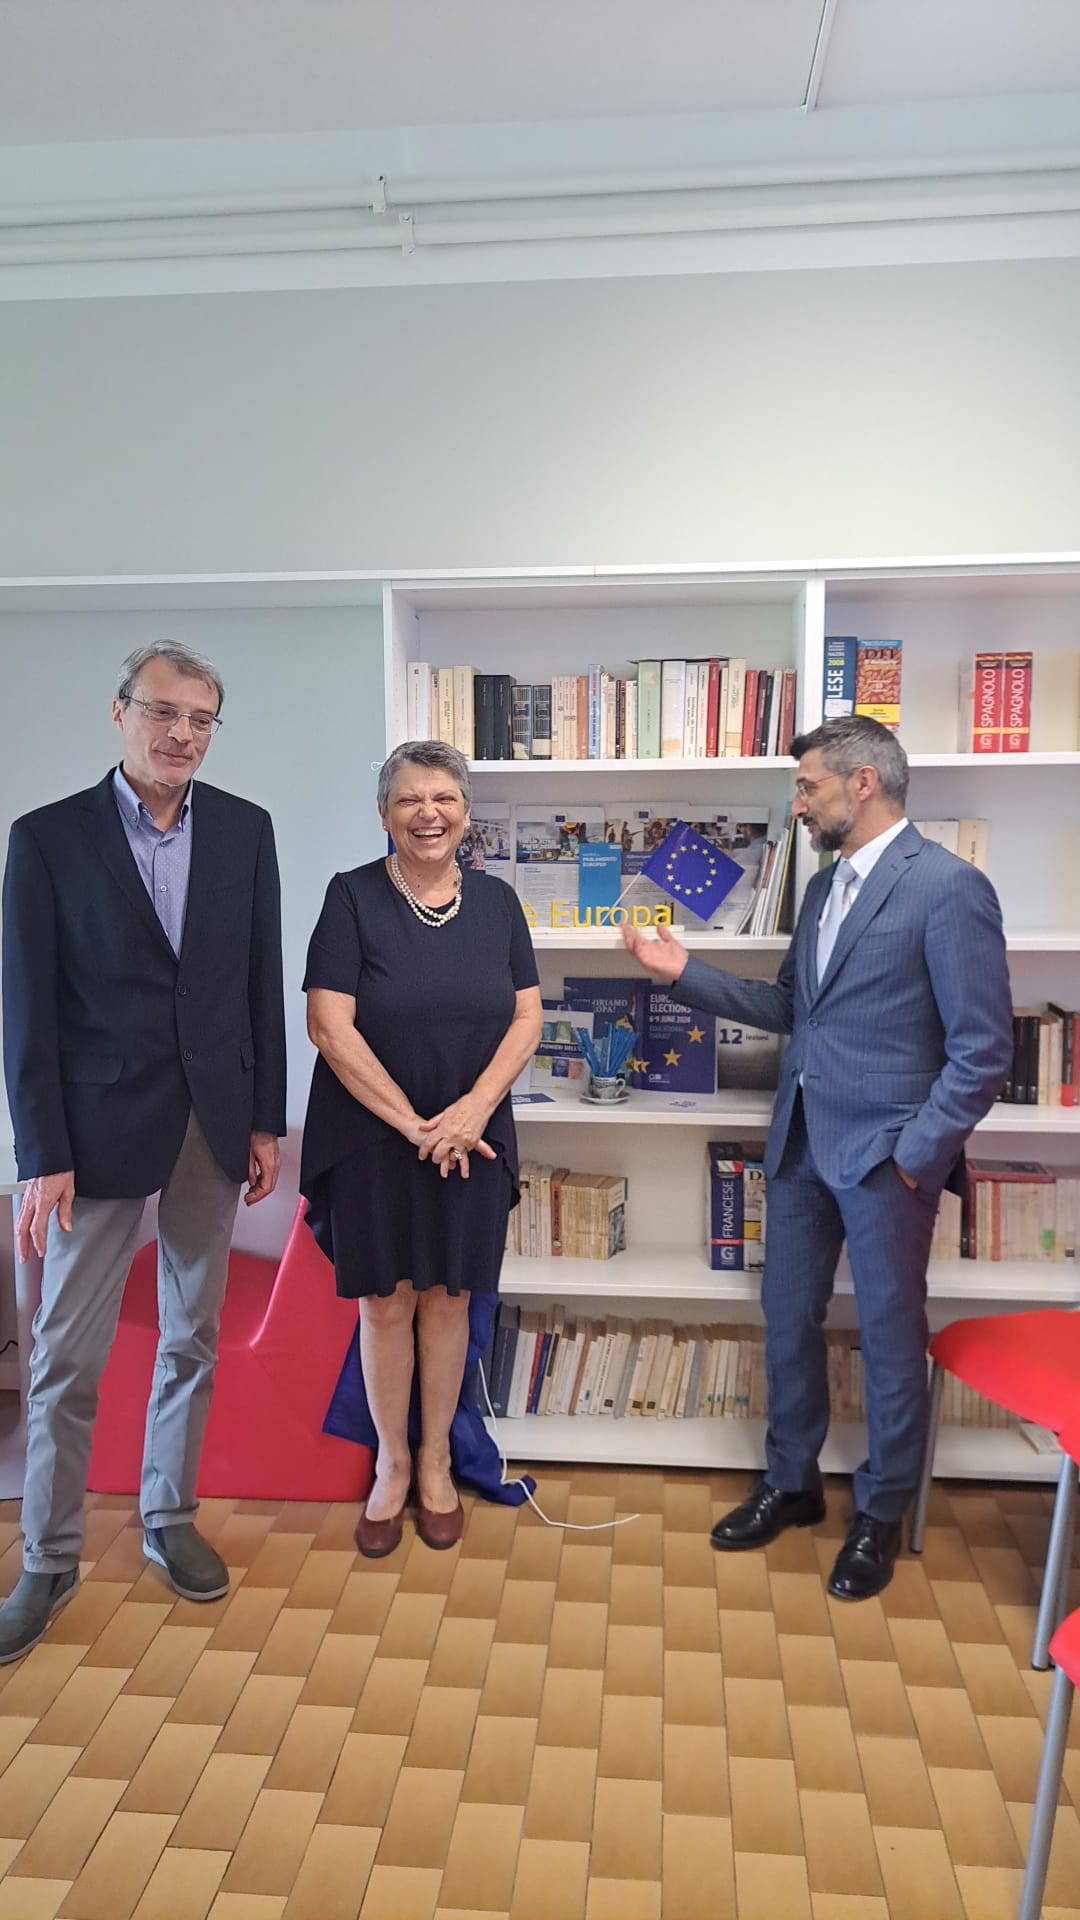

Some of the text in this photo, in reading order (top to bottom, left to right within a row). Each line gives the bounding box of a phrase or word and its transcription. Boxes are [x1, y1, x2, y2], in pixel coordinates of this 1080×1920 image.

[827, 669, 844, 698] LESE
[981, 669, 996, 727] SPAGNOLO
[1010, 668, 1025, 727] SPAGNOLO
[551, 900, 673, 928] Europa
[592, 999, 628, 1007] ORIAMO
[650, 994, 671, 1003] EURO
[650, 1003, 692, 1013] ELECTIONS
[661, 1015, 676, 1023] JUNE
[719, 1028, 743, 1044] 12
[750, 1171, 762, 1180] D
[722, 1181, 734, 1238] FRANCESE
